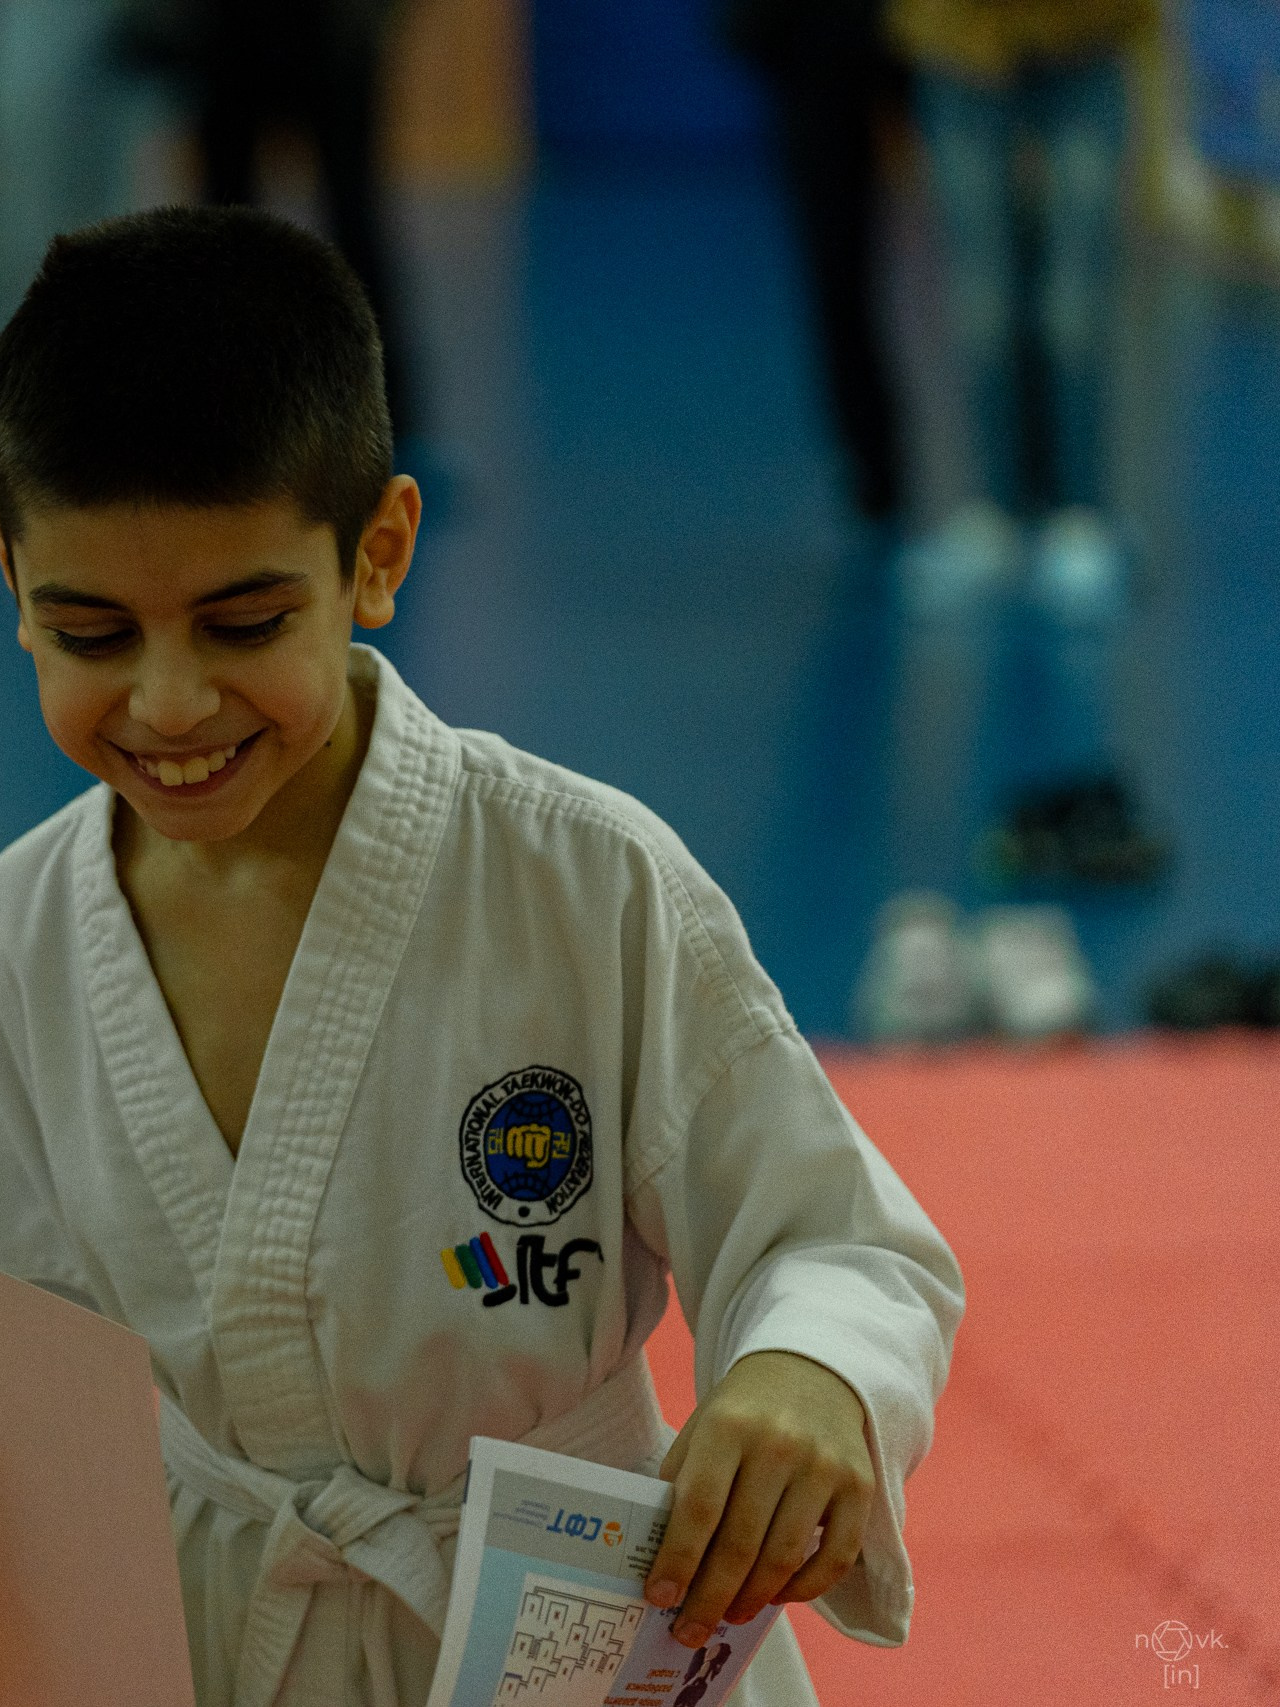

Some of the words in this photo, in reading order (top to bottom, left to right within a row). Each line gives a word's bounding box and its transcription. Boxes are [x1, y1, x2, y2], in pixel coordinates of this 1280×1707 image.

[464, 1091, 505, 1211] INTERNATIONAL
[500, 1071, 589, 1126] TAEKWON-DO
[545, 1129, 591, 1215] FEDERATION
[546, 1508, 603, 1542] СФТ
